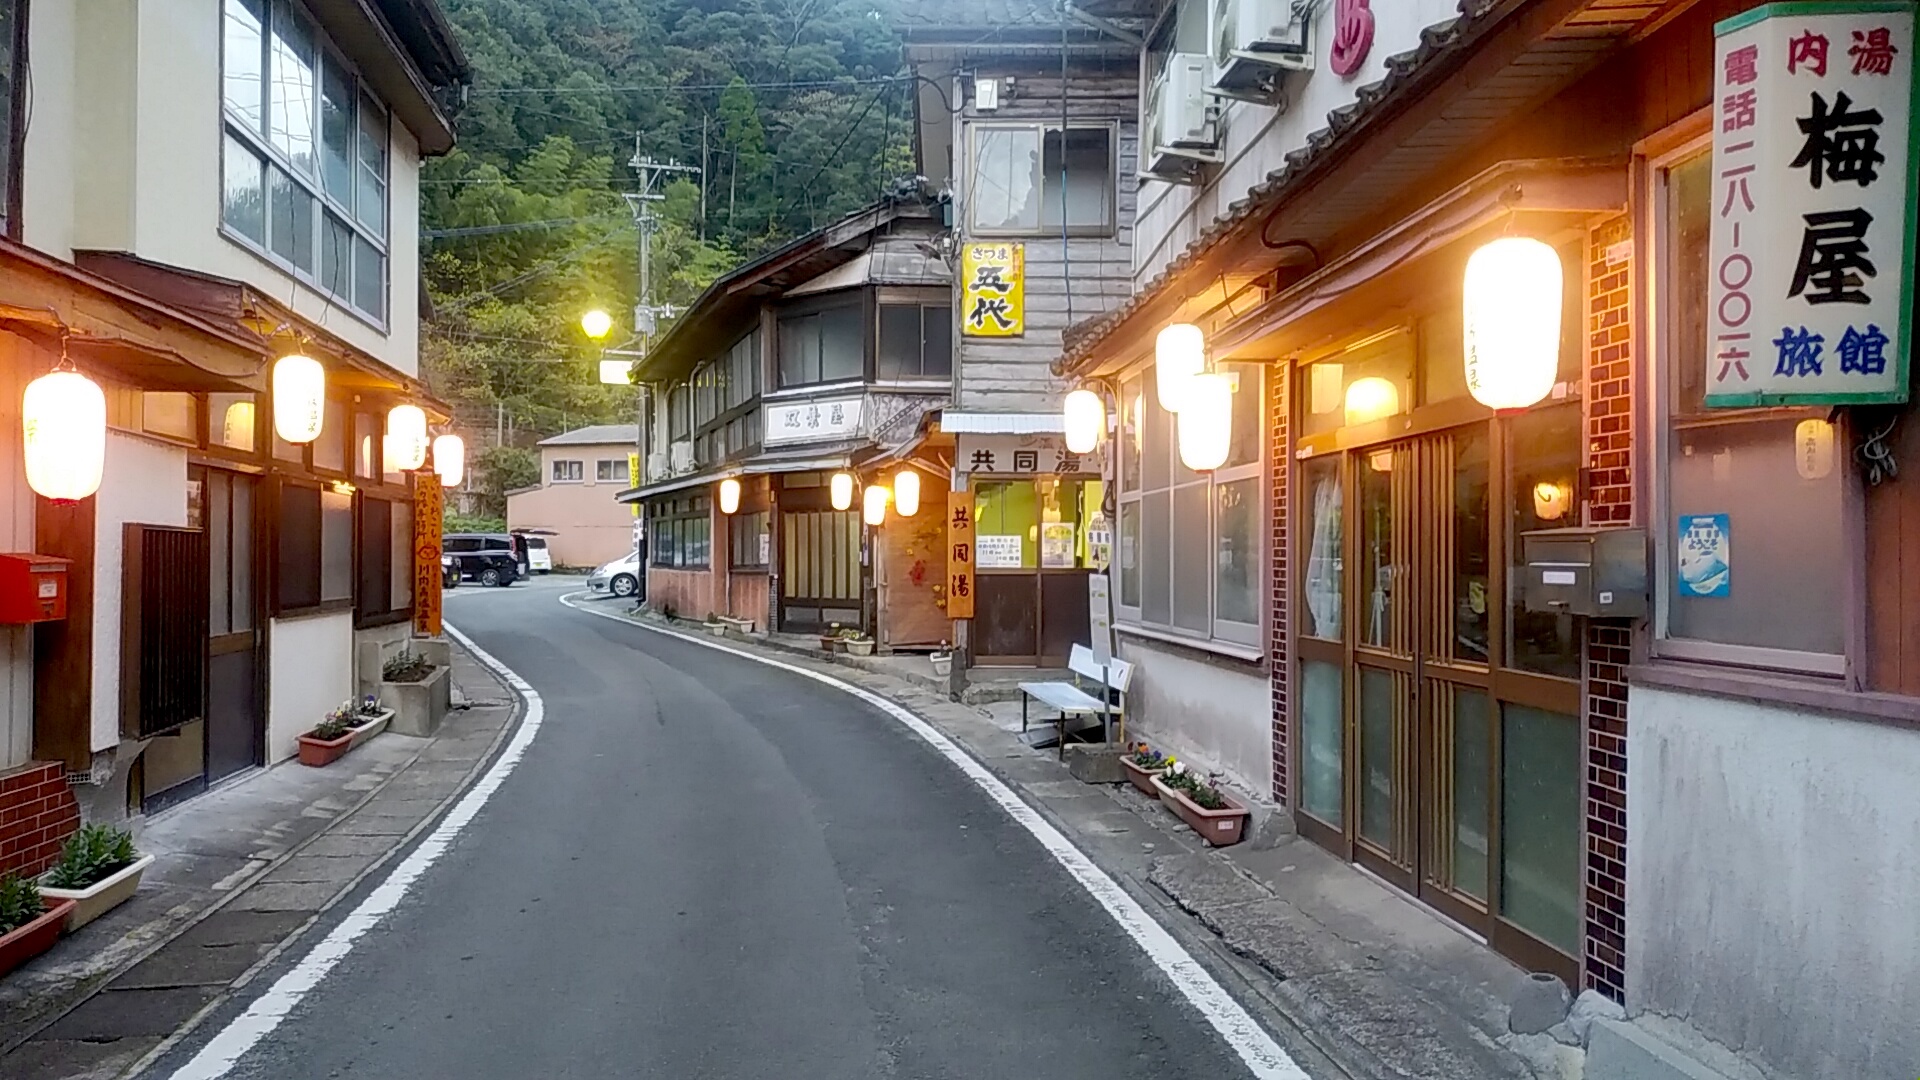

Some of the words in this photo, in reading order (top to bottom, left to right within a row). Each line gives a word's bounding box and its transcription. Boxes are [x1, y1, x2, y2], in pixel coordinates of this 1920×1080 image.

[1787, 27, 1898, 77] 内湯
[1787, 91, 1885, 306] 梅屋
[972, 247, 1008, 260] さつま
[968, 266, 1013, 329] 五代
[1773, 324, 1891, 378] 旅館
[970, 449, 1081, 473] 共同湯
[951, 505, 970, 597] 共同湯
